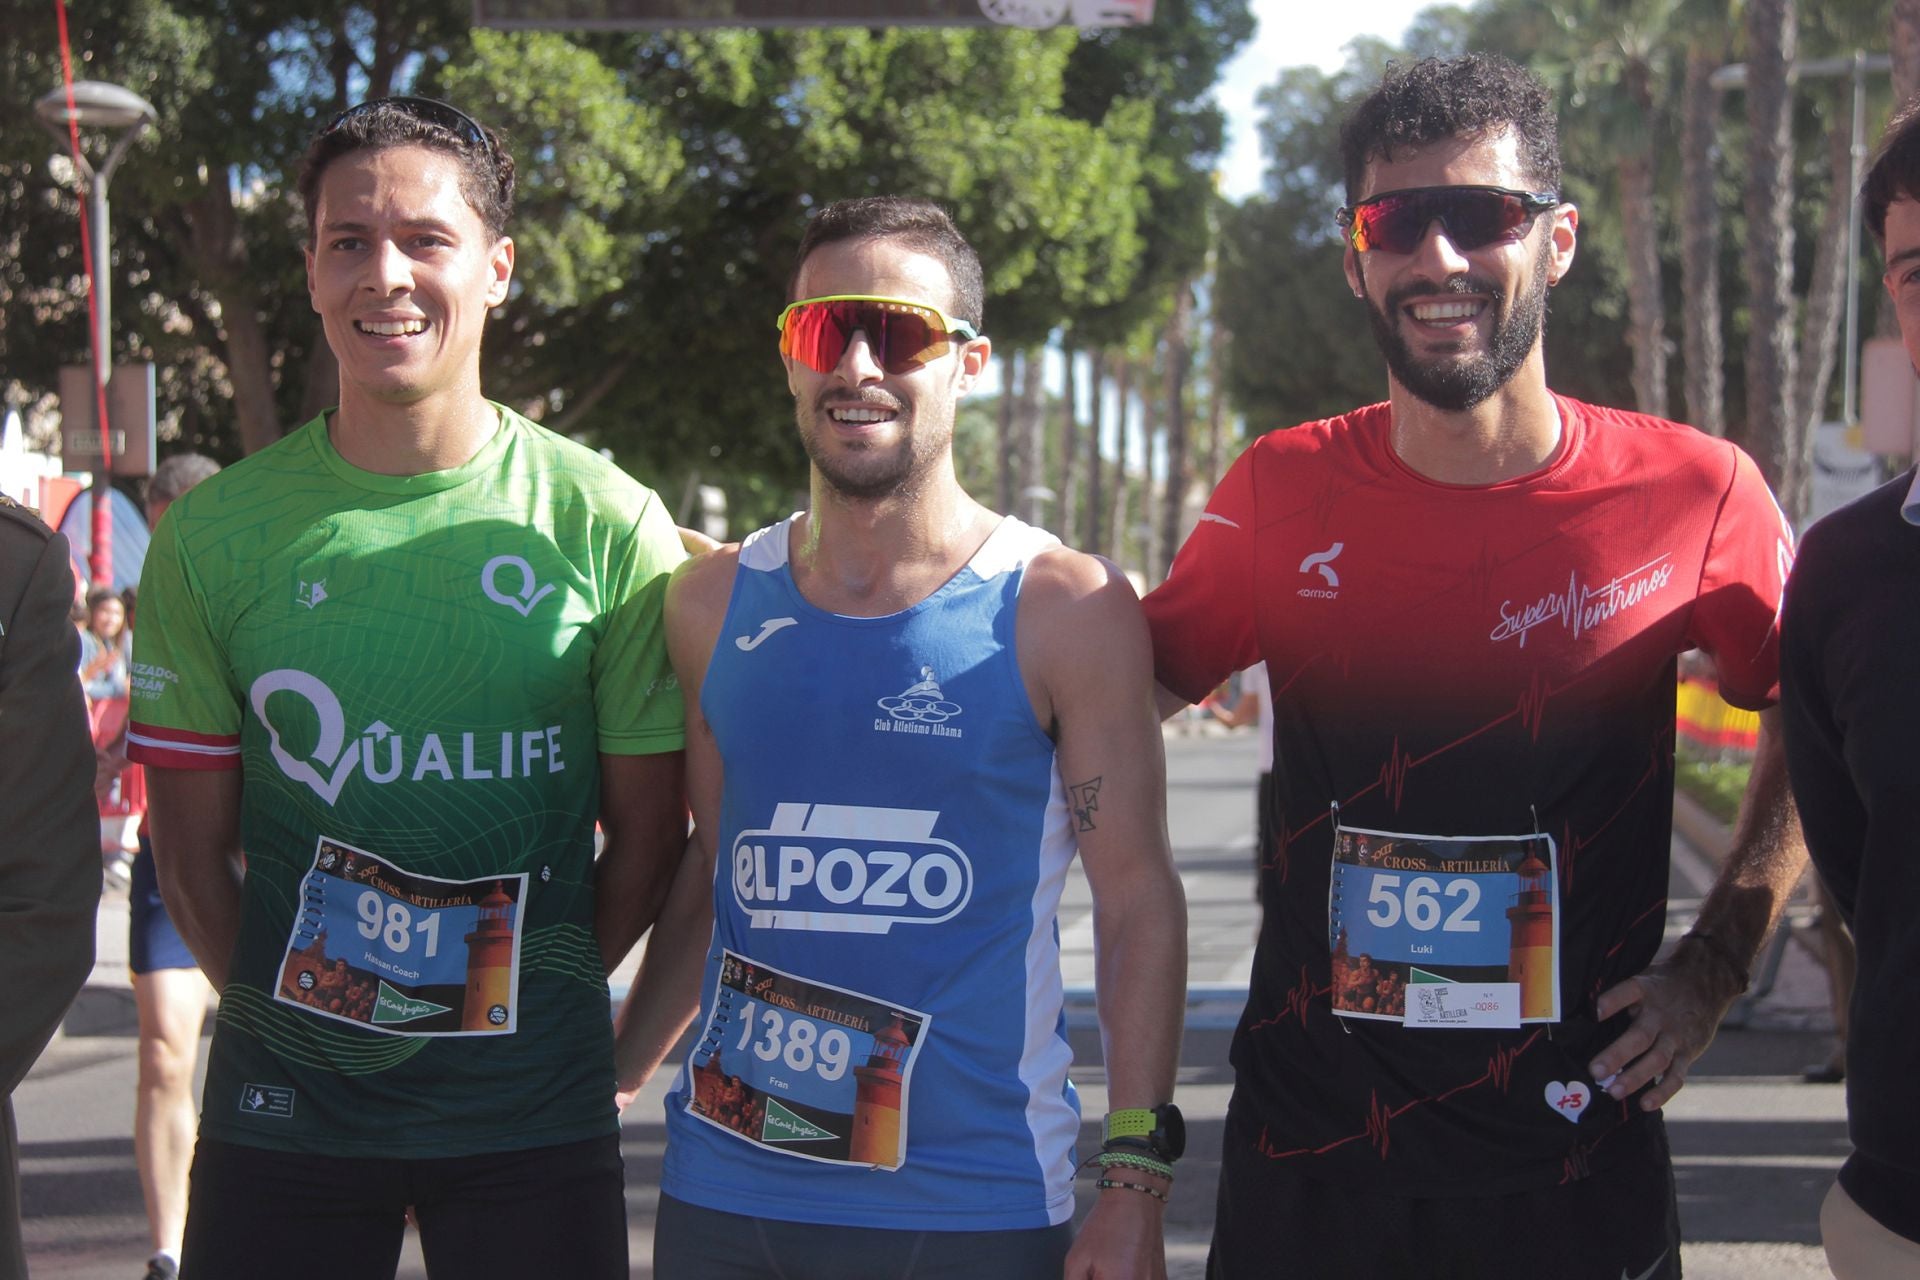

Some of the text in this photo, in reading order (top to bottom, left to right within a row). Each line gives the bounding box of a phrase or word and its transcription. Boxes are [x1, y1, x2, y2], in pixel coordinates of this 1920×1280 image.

[250, 668, 566, 808] QUALIFE
[874, 718, 962, 738] Club Atletismo Alhama
[1383, 857, 1511, 873] CROSS ARTILLERÍA
[370, 875, 472, 909] CROSS ARTILLERÍA
[1367, 873, 1481, 933] 562
[356, 890, 440, 958] 981
[1411, 943, 1433, 955] Luki
[364, 951, 420, 980] Hassan Coach
[763, 989, 870, 1033] CROSS ARTILLERÍA
[1475, 1002, 1499, 1011] 0086
[736, 1001, 851, 1082] 1389
[769, 1076, 789, 1090] Fran
[1557, 1093, 1582, 1109] +3
